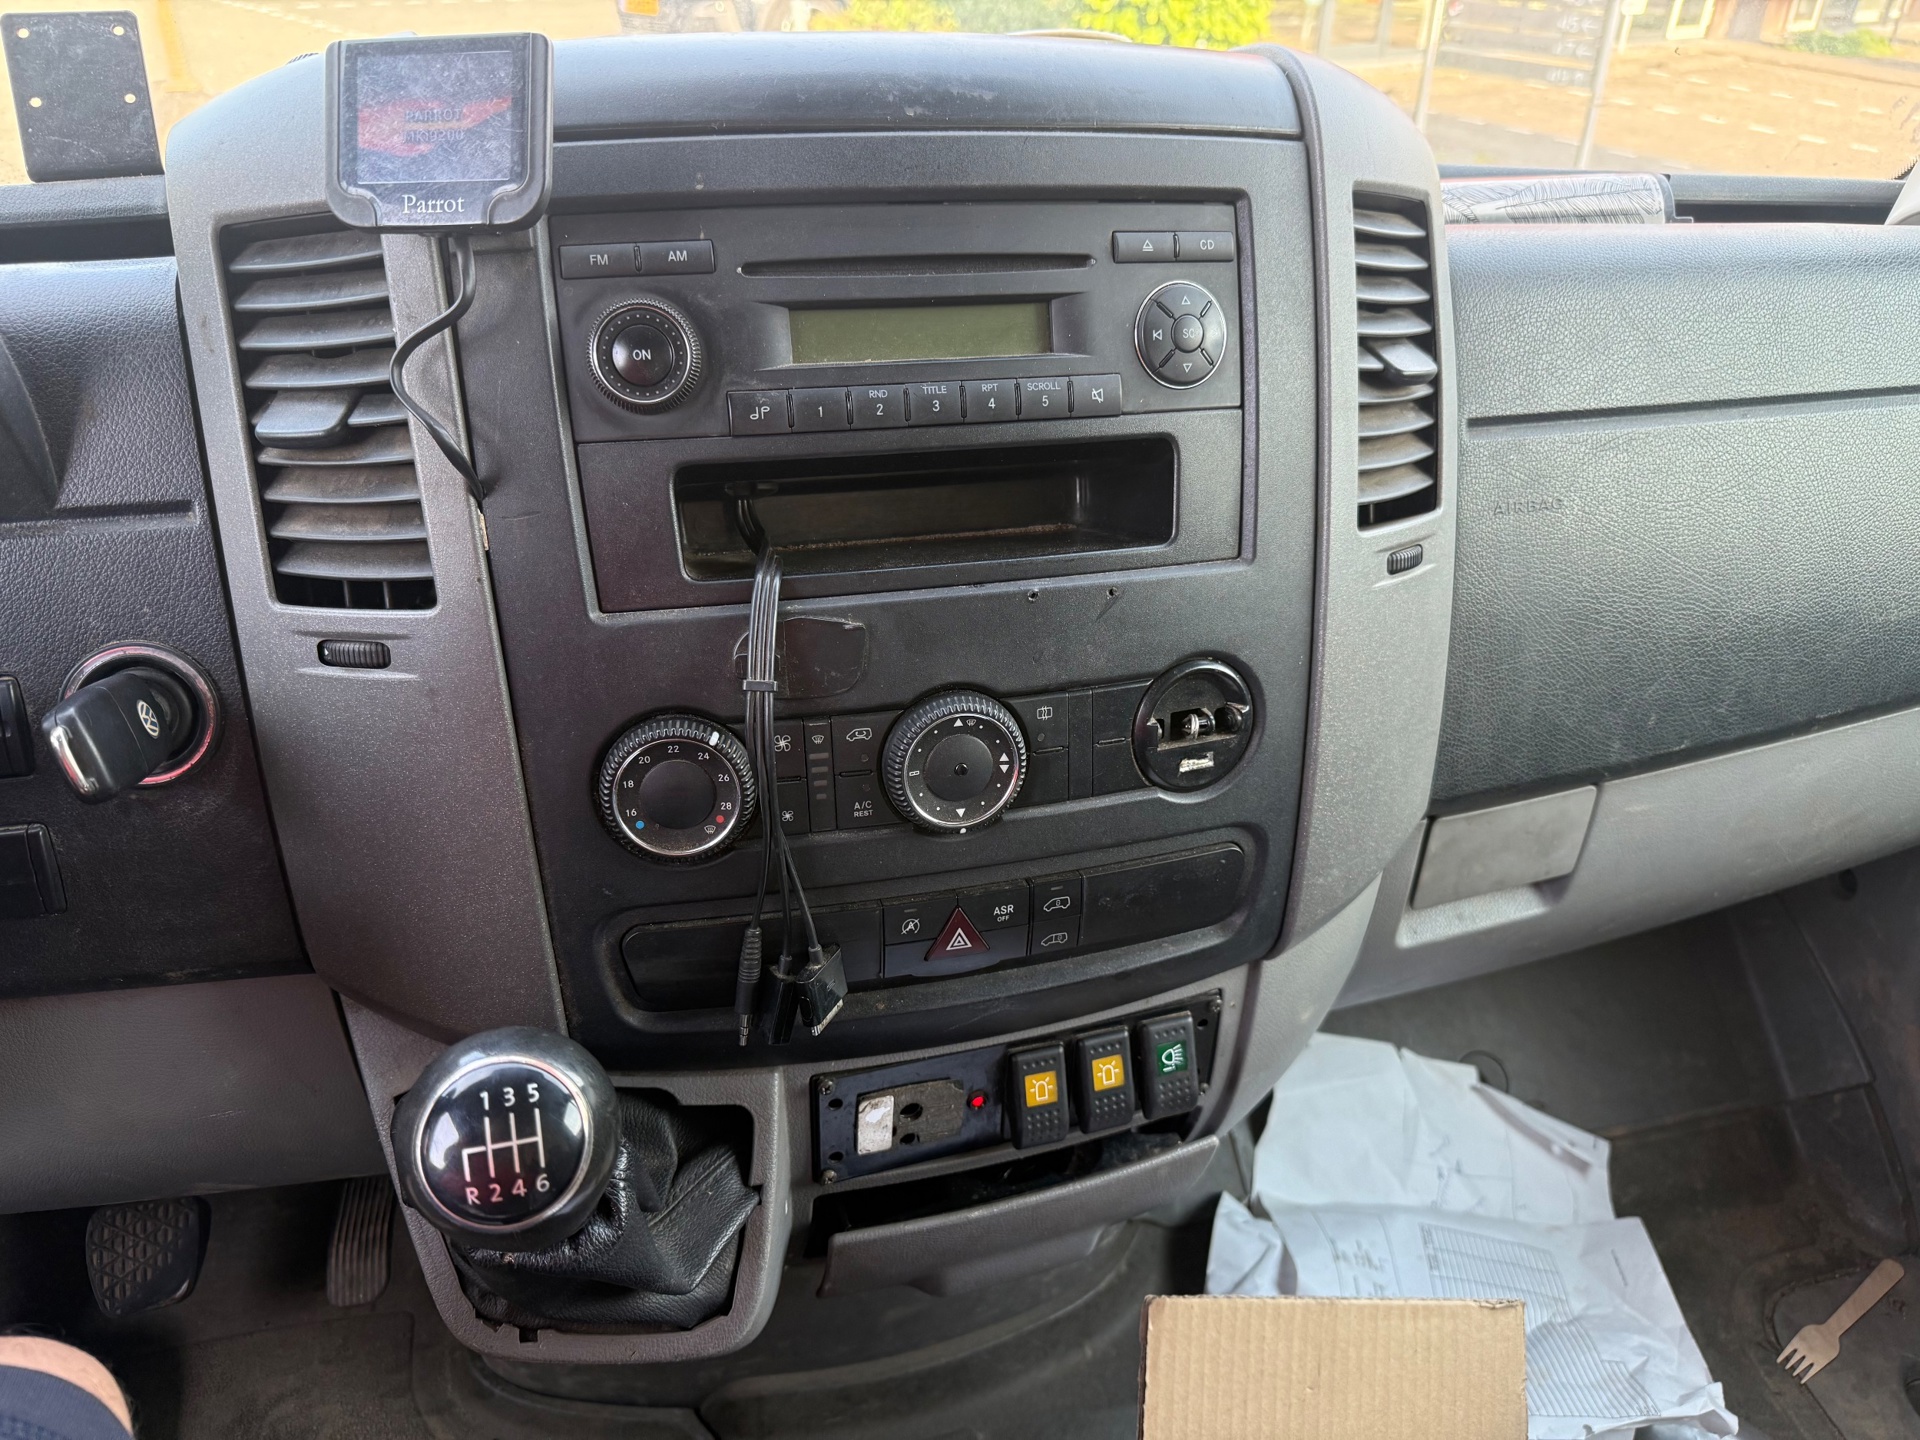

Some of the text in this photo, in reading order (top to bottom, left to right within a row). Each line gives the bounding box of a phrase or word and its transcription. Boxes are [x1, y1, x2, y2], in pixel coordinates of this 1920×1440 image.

[405, 108, 462, 121] PARROT
[402, 194, 465, 214] Parrot
[1200, 239, 1215, 250] CD
[589, 254, 609, 266] FM
[667, 250, 688, 262] AM
[632, 349, 652, 361] ON
[921, 385, 947, 395] TITLE
[981, 383, 999, 393] RPT
[1027, 381, 1061, 392] SCROLL
[868, 389, 888, 399] RND
[932, 400, 940, 412] 3
[988, 398, 996, 410] 4
[1042, 395, 1049, 407] 5
[817, 406, 823, 418] 1
[876, 404, 884, 416] 2
[1493, 497, 1563, 516] AIRBAG
[667, 745, 680, 754] 22
[638, 755, 651, 764] 20
[697, 752, 710, 761] 24
[718, 774, 730, 782] 26
[622, 780, 635, 789] 18
[720, 802, 732, 811] 28
[853, 800, 872, 810] A/C
[625, 808, 637, 817] 16
[853, 809, 873, 818] REST
[994, 905, 1014, 915] ASR
[480, 1083, 540, 1110] 1 3 5
[466, 1174, 550, 1205] R 2 4 6
